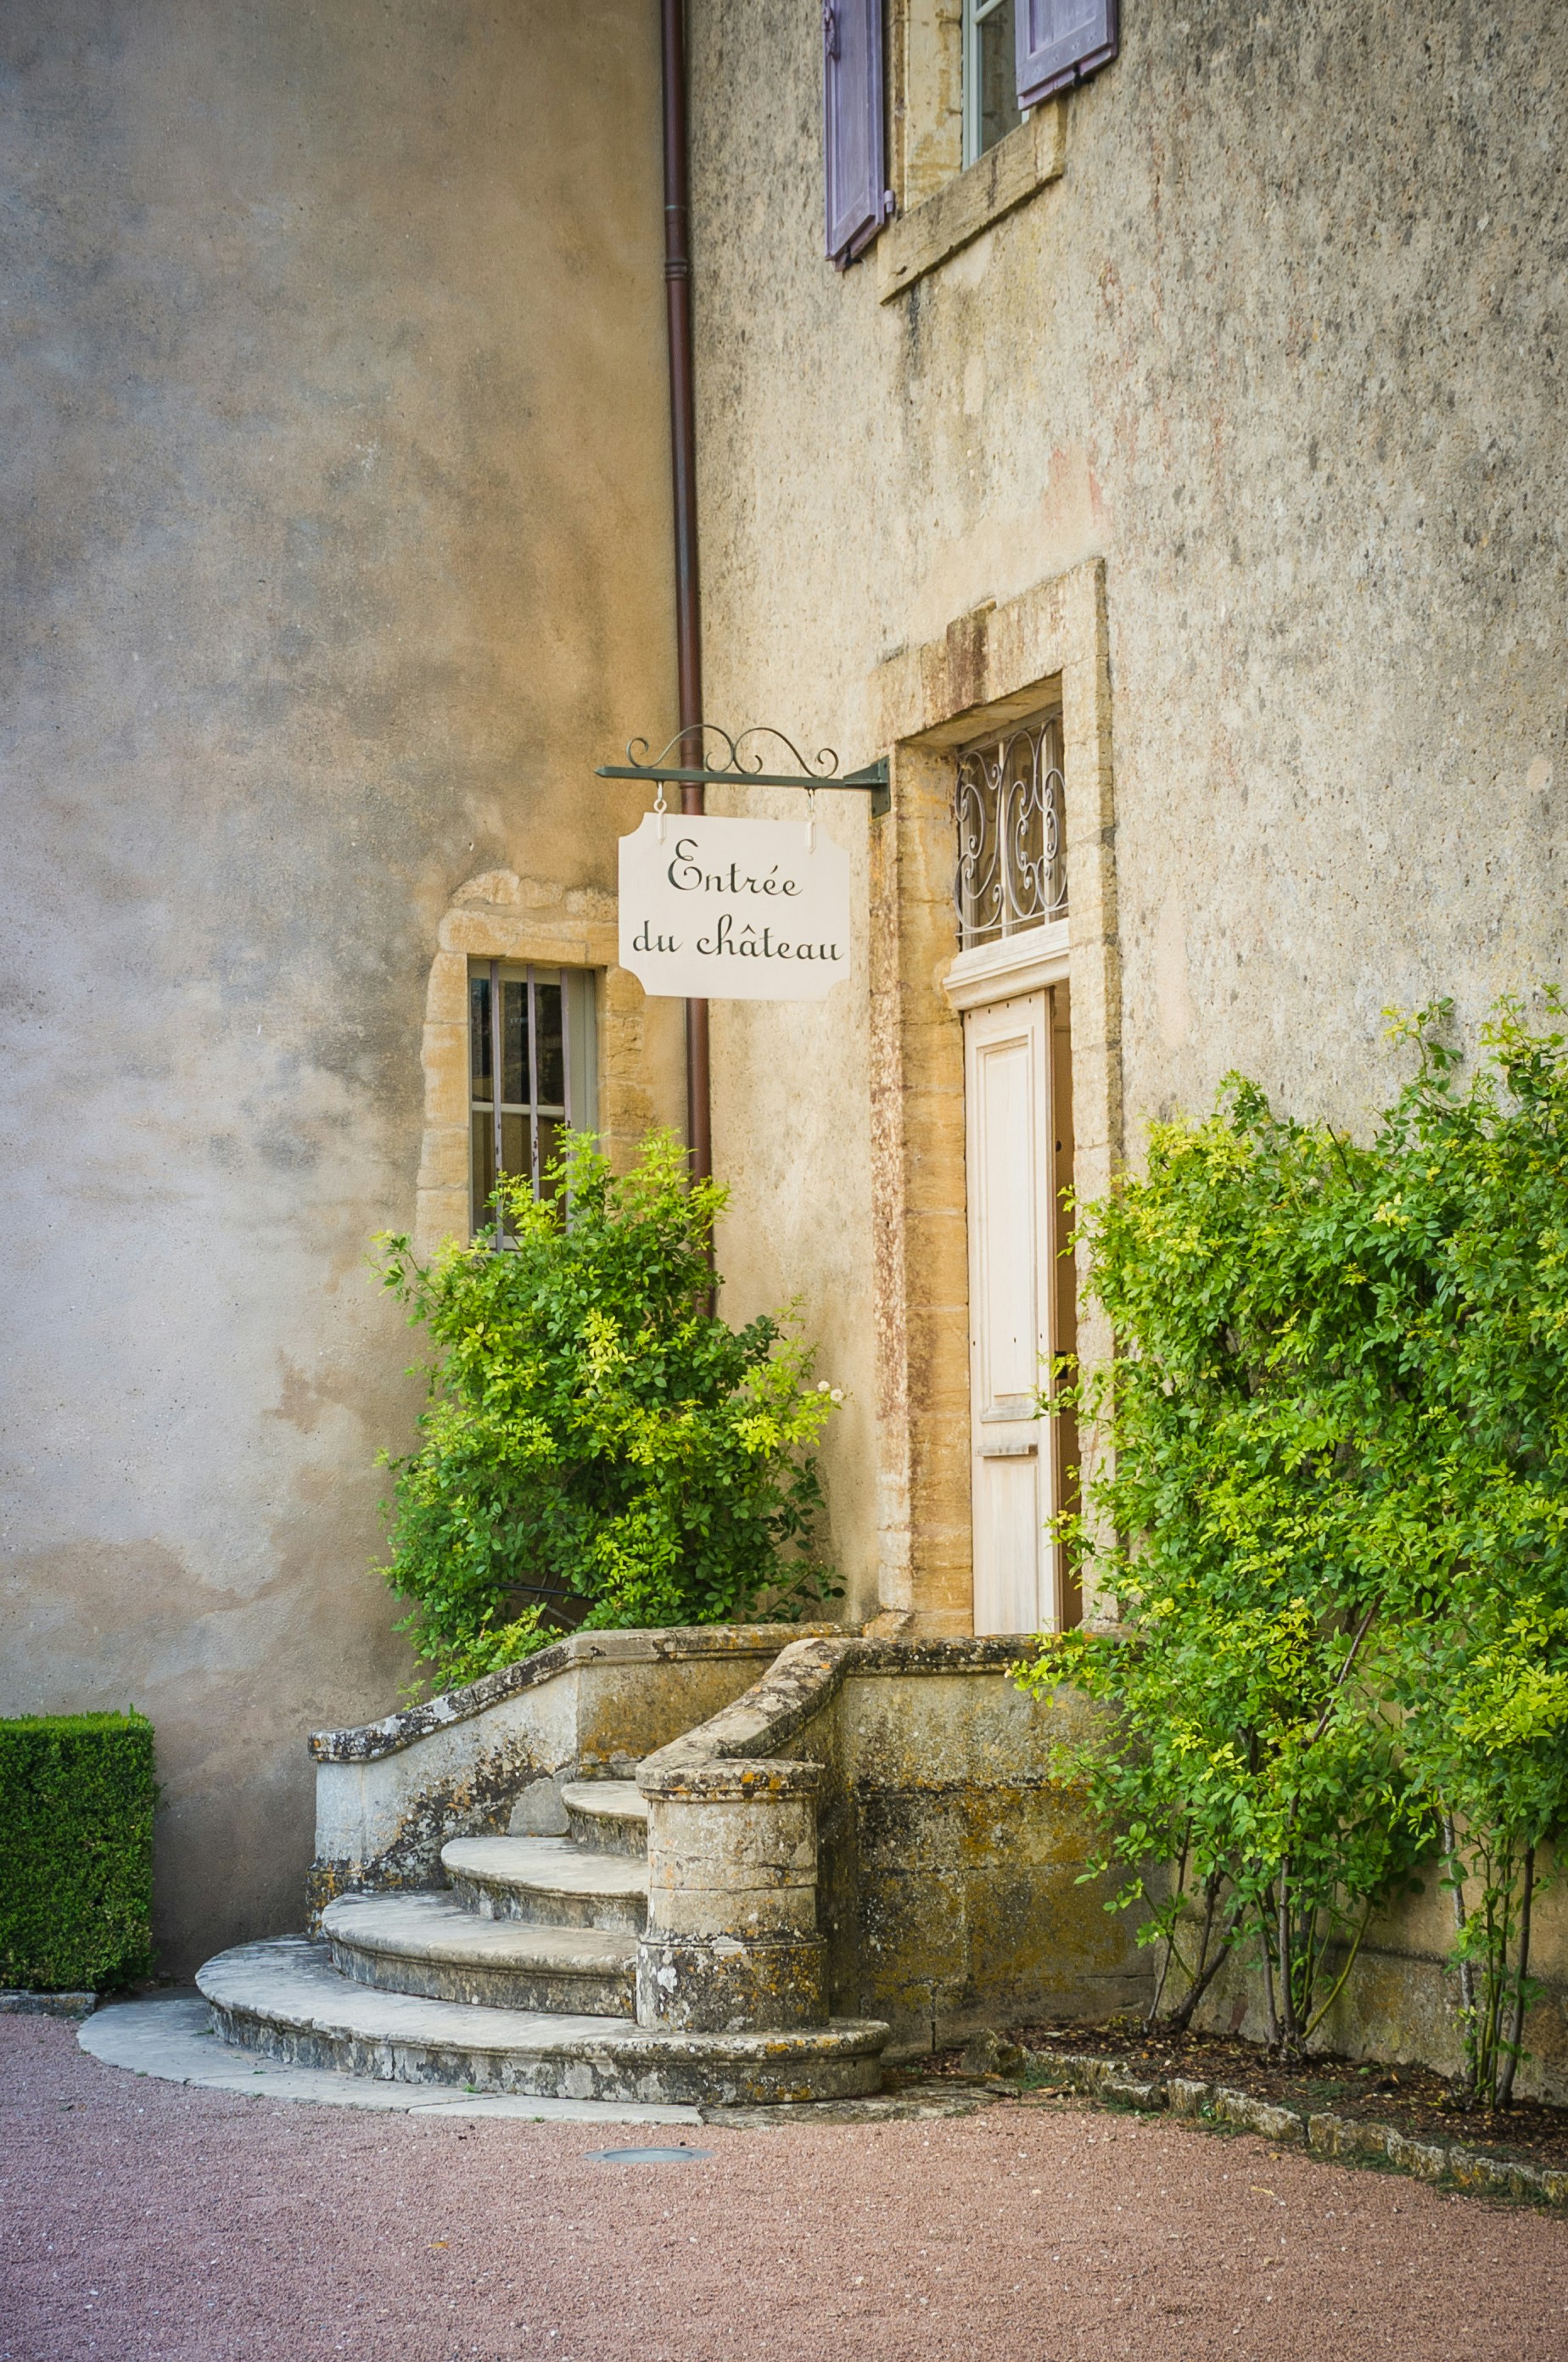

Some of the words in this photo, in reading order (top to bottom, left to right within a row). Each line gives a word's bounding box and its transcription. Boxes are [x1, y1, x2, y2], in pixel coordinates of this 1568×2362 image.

[668, 838, 804, 897] Entrée
[632, 920, 683, 953] du
[696, 914, 844, 960] château
